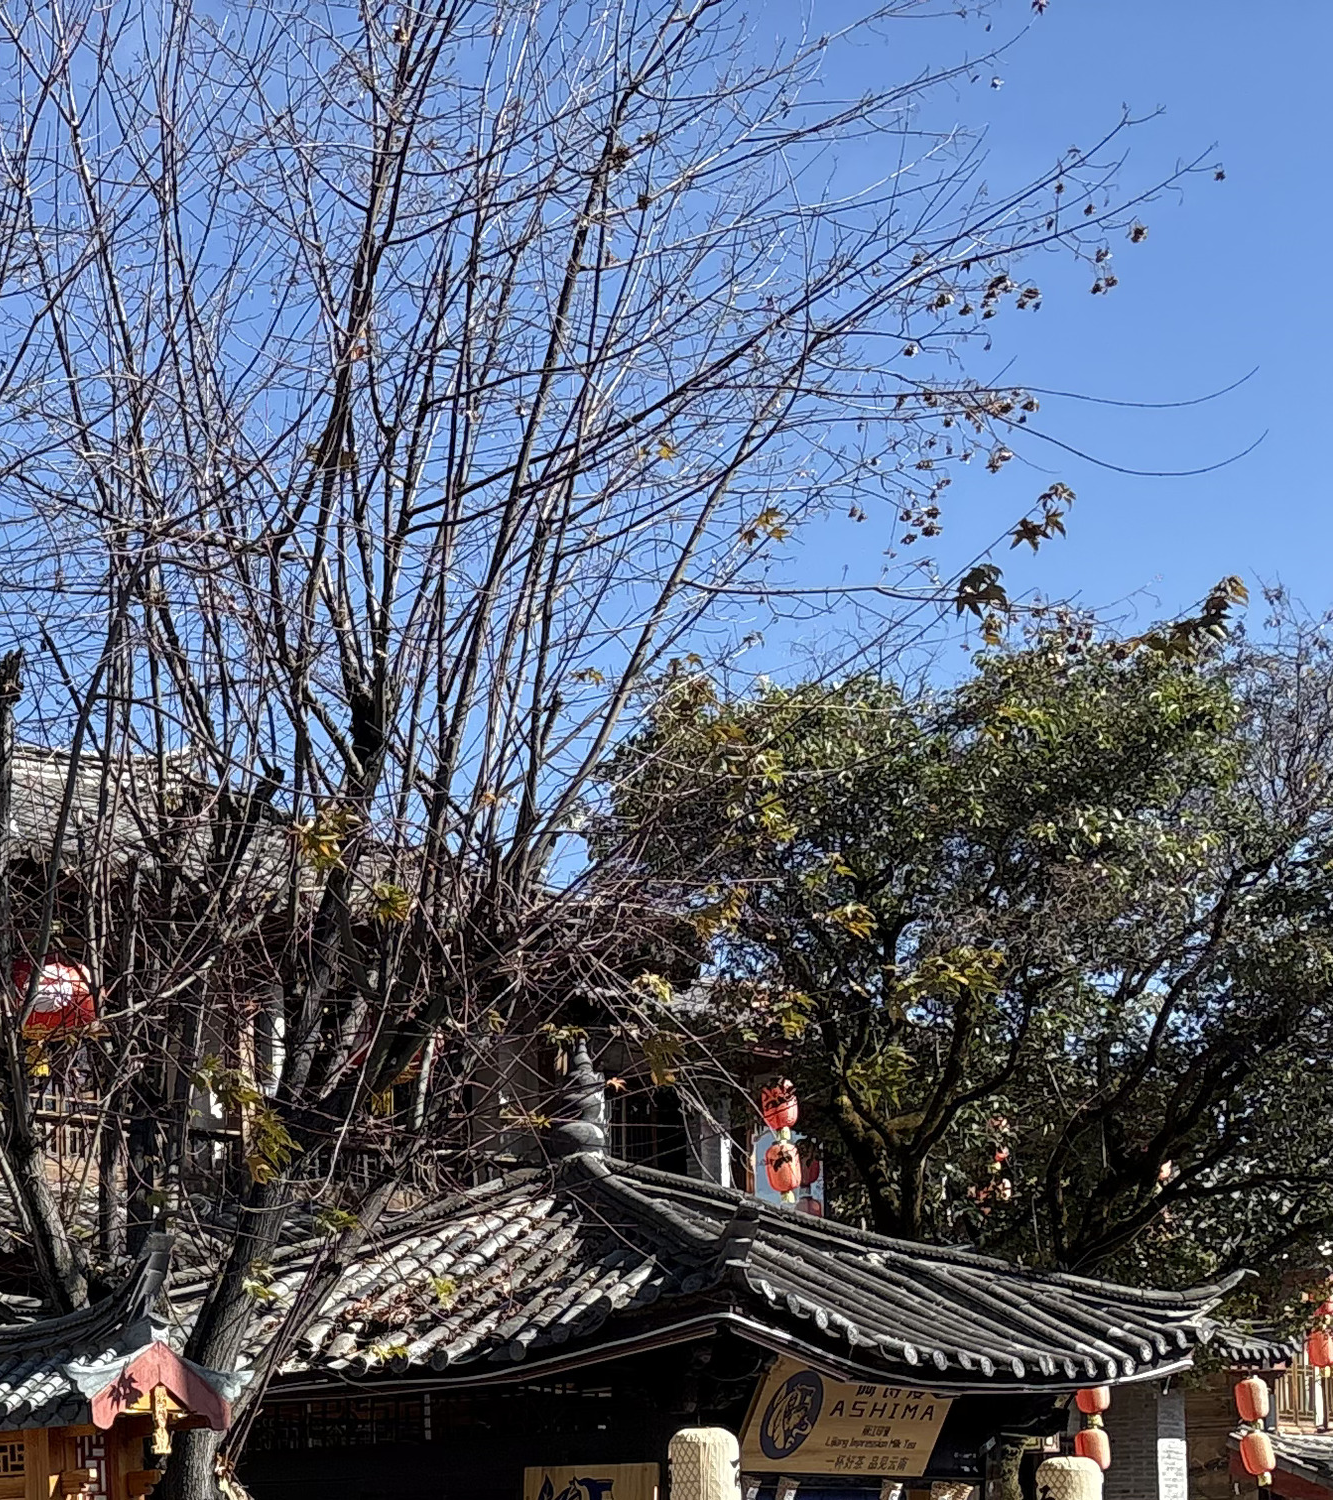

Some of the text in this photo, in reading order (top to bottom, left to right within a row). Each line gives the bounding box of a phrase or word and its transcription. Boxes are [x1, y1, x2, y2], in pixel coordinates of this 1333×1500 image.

[829, 1400, 935, 1422] ASHIMA
[849, 1437, 887, 1449] Impression
[889, 1439, 901, 1449] Milk
[903, 1440, 917, 1450] Tea
[826, 1455, 866, 1470] 一杯好茶
